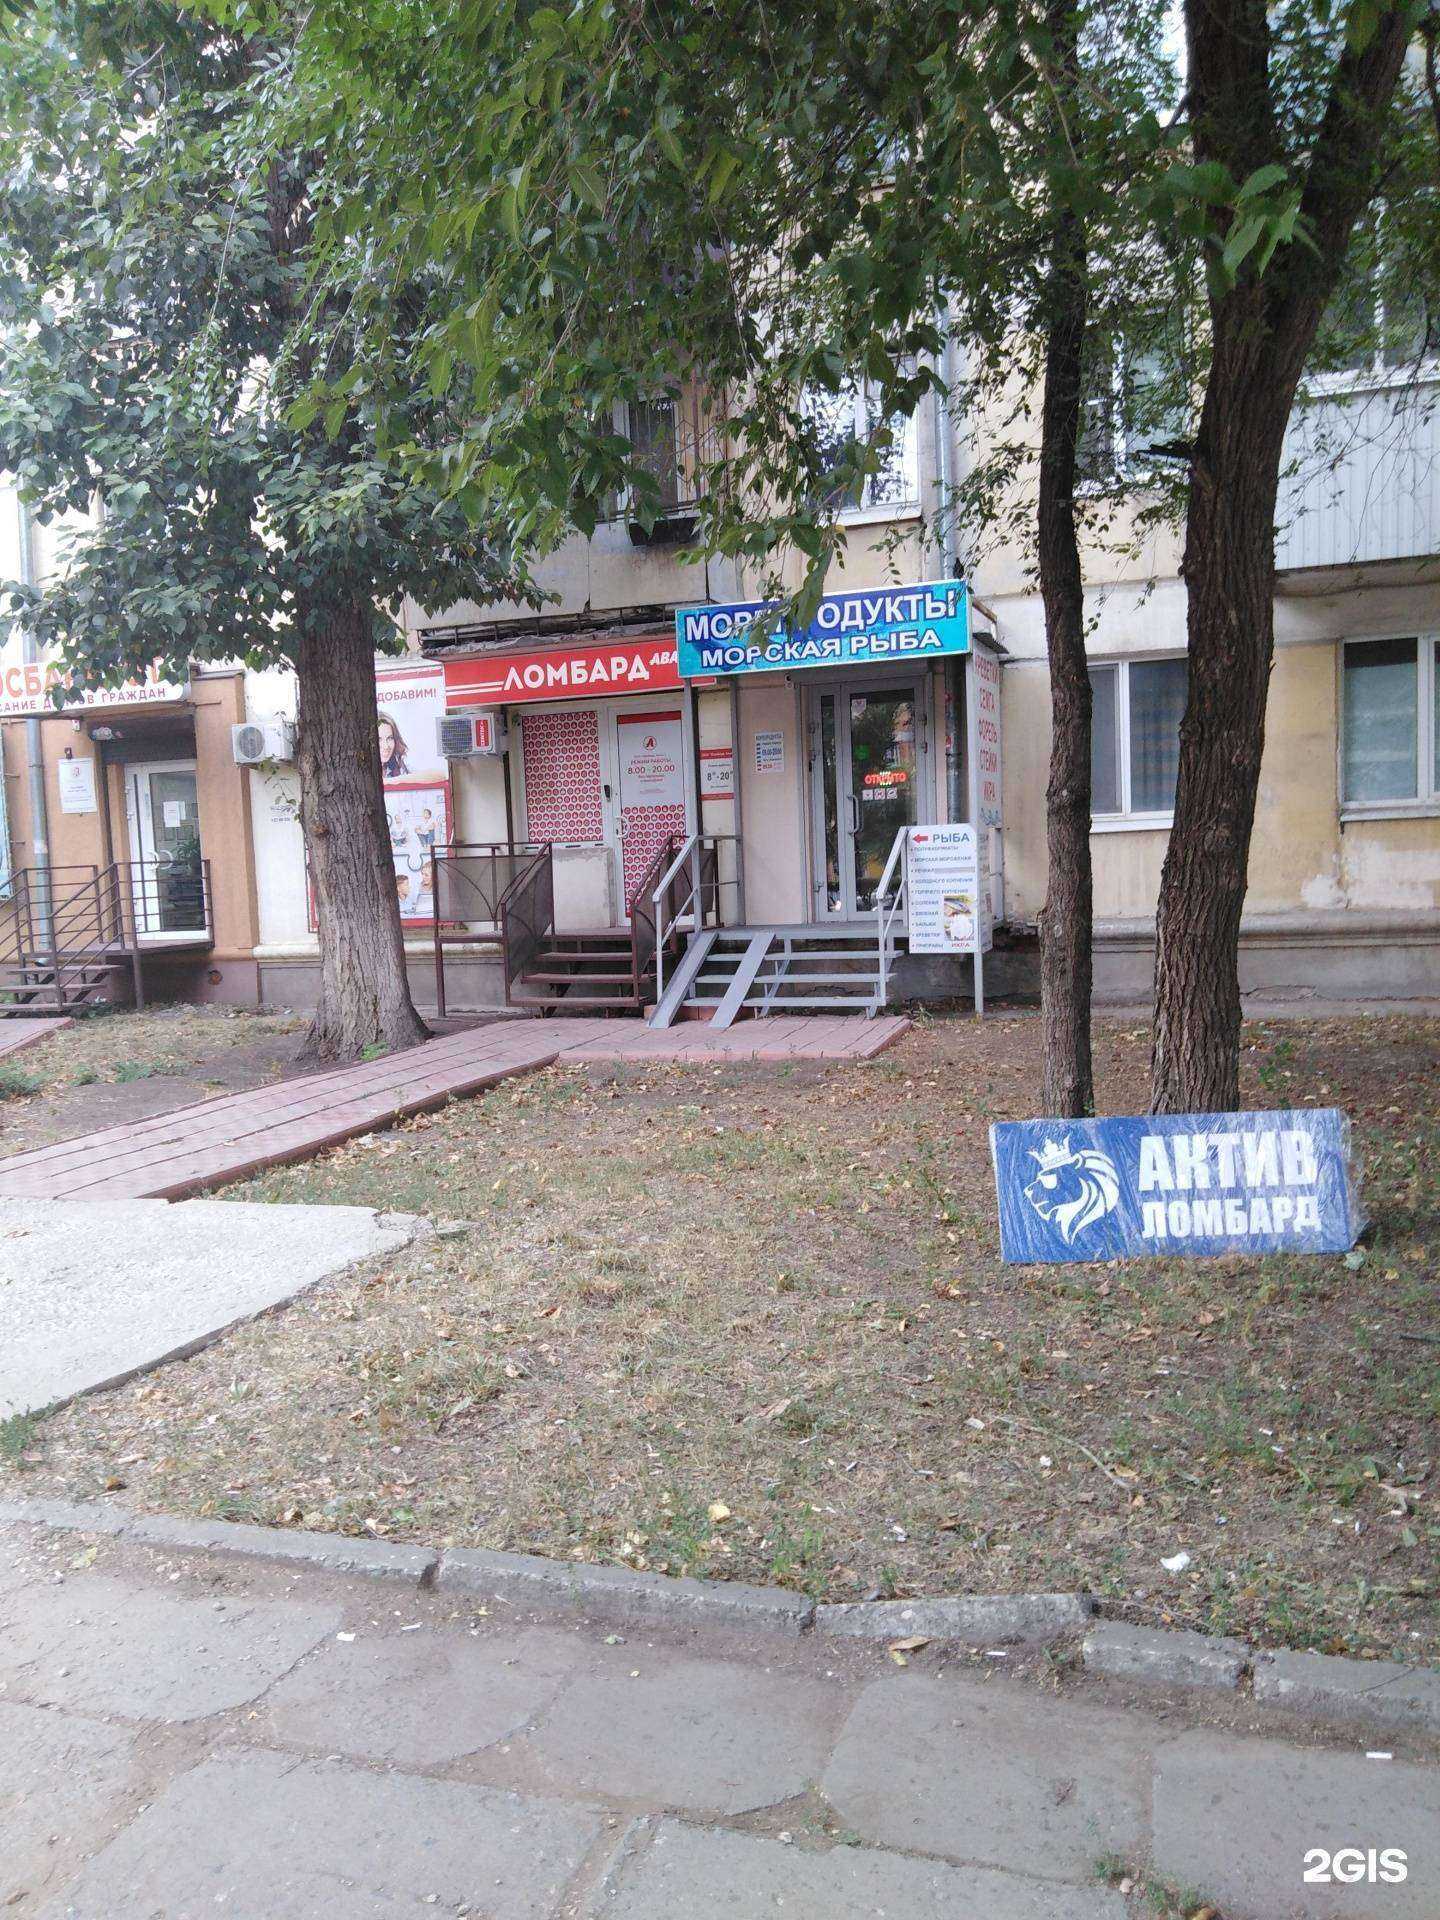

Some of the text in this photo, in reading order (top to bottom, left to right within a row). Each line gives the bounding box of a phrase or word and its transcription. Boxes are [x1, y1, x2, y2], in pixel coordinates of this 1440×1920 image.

[685, 588, 957, 643] МОРОДУКТЫ
[702, 628, 942, 667] МОРСКАЯ РЫБА
[503, 653, 650, 691] ЛОМБАРД
[102, 687, 166, 701] ГРАЖДАН
[652, 764, 675, 773] 20.00
[932, 832, 970, 843] РЫБА
[1138, 1130, 1318, 1191] АКТИВ
[1141, 1196, 1322, 1239] ЛОМБАРД
